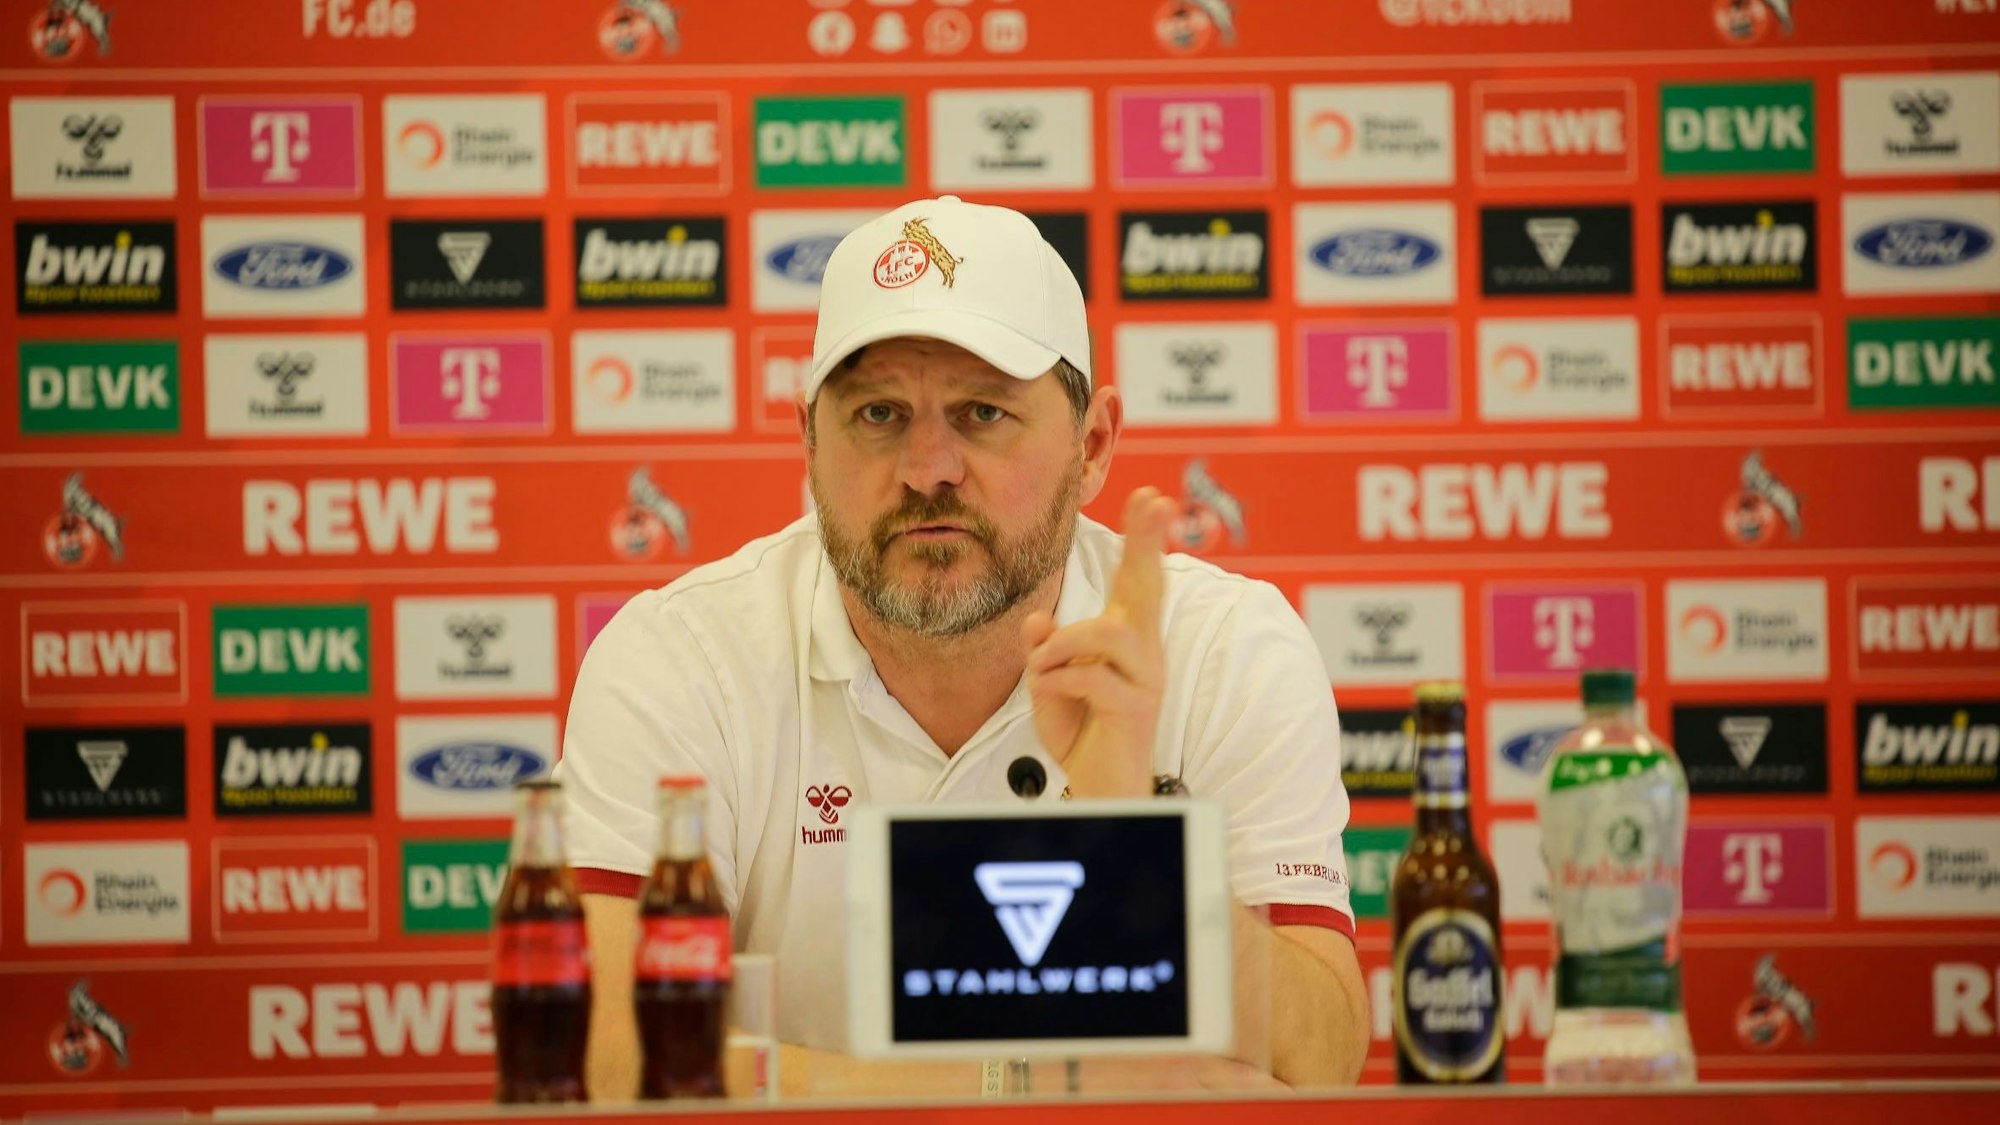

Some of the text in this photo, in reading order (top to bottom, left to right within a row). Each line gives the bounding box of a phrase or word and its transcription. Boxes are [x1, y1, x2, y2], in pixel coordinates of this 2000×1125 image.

[577, 122, 719, 167] REWE
[759, 121, 901, 165] DEVK
[1483, 110, 1628, 155] REWE
[1665, 106, 1806, 151] DEVK
[25, 231, 166, 284] bwin
[579, 226, 720, 282] bwin
[1122, 219, 1264, 276] bwin
[1668, 212, 1807, 266] bwin
[28, 365, 169, 410] DEVK
[1670, 343, 1813, 391] REWE
[1853, 341, 1995, 387] DEVK
[242, 477, 499, 556] REWE
[1357, 463, 1612, 541] REWE
[220, 630, 362, 674] DEVK
[1860, 605, 2000, 653] REWE
[32, 630, 176, 678] REWE
[220, 733, 362, 788] bwin
[1863, 712, 2000, 765] bwin
[802, 827, 848, 844] humm
[223, 867, 365, 912] REWE
[408, 866, 506, 909] DEV
[248, 981, 496, 1059] REWE
